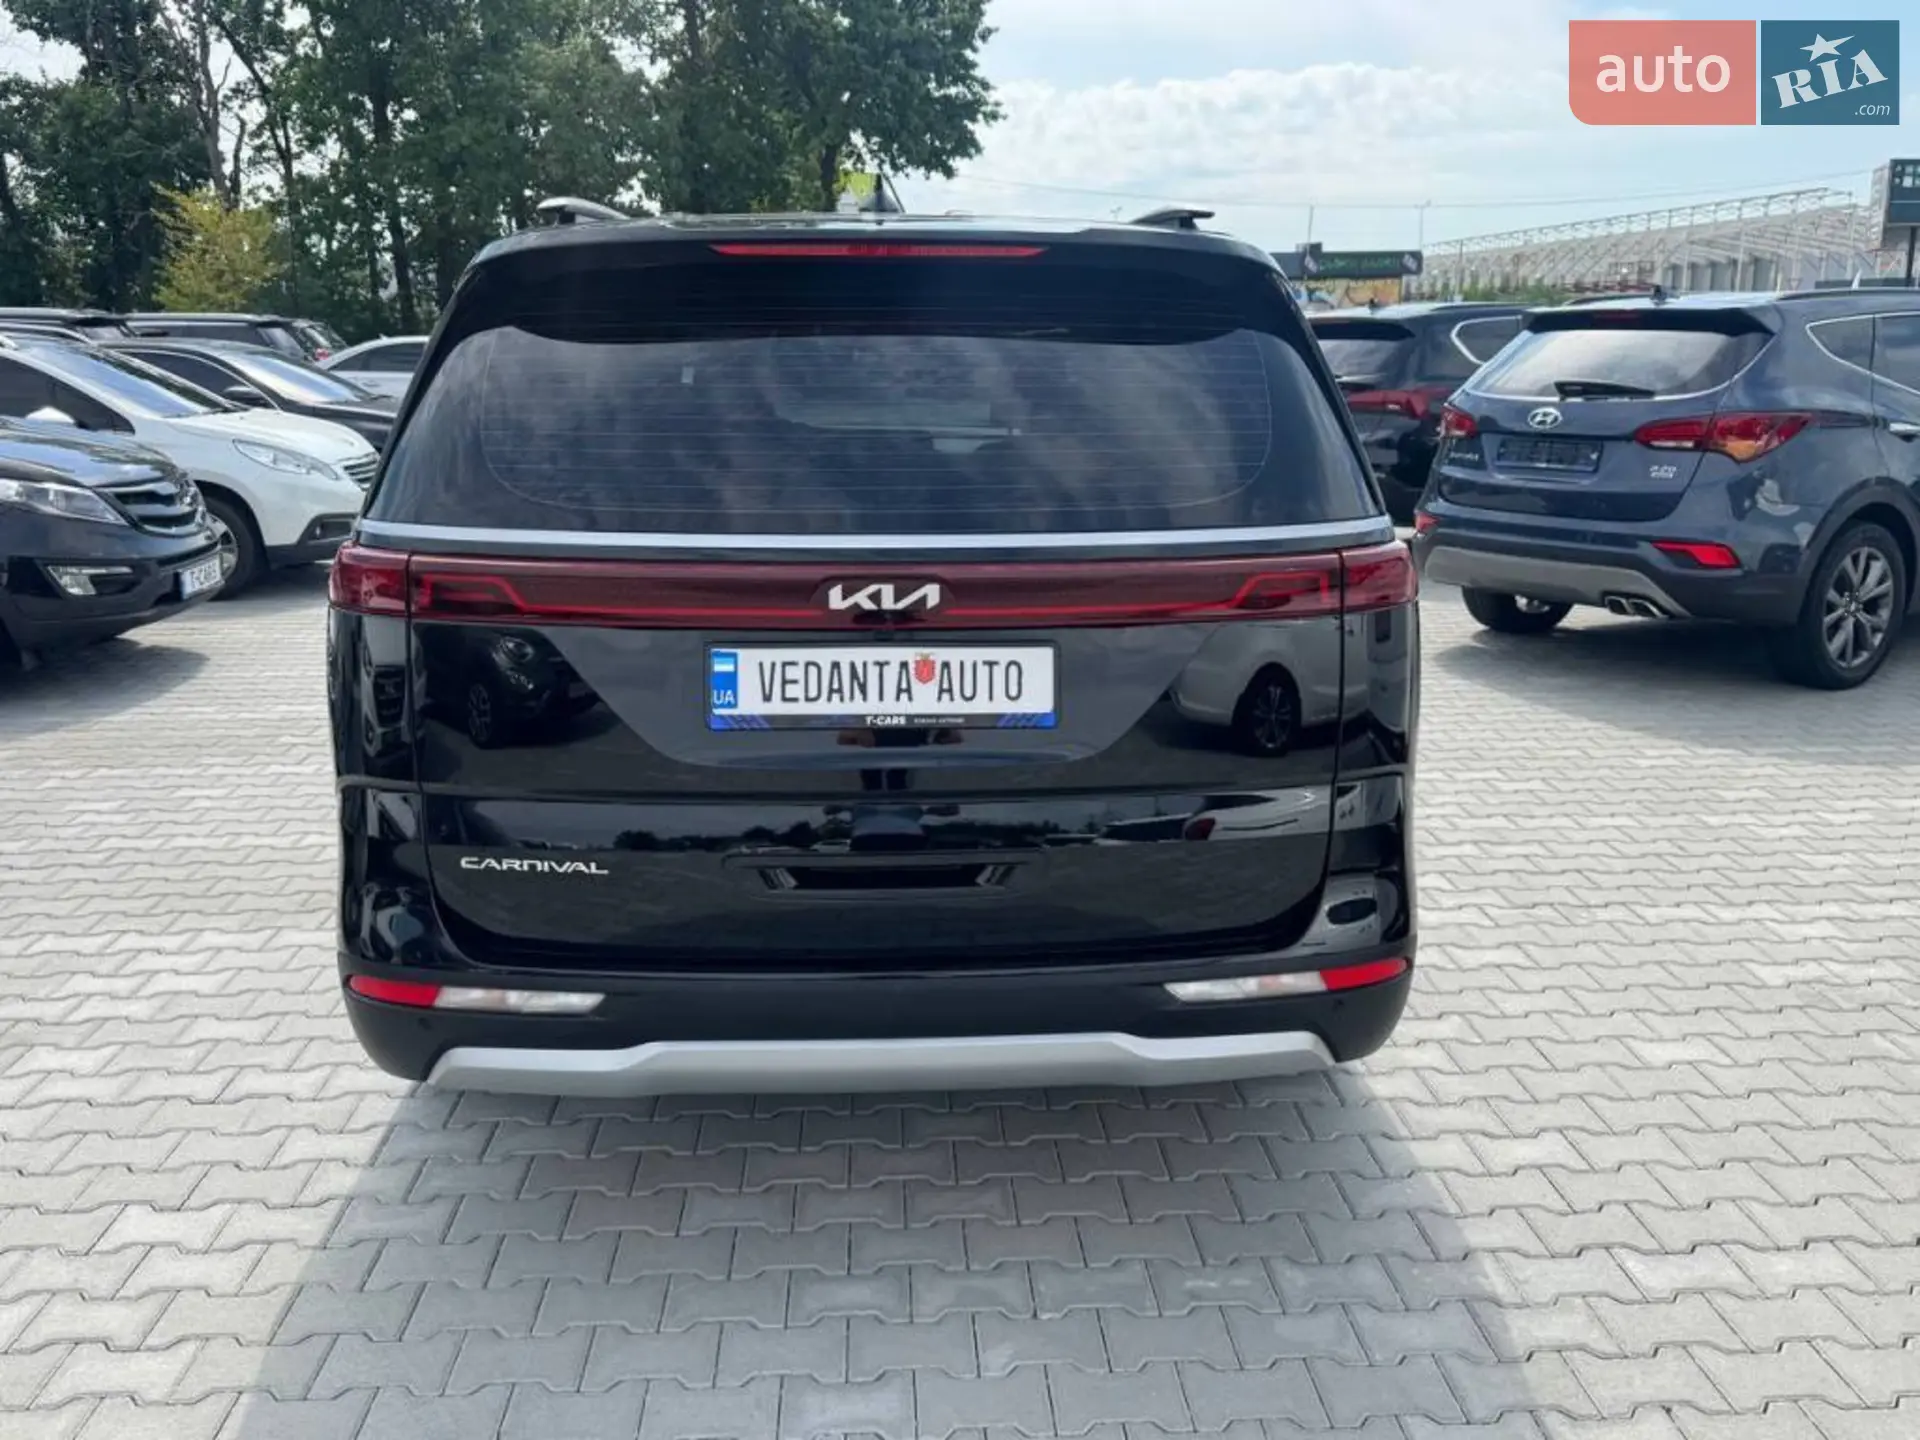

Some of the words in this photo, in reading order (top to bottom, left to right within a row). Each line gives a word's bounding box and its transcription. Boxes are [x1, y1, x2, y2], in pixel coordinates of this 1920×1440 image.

[828, 582, 941, 611] KIA
[758, 660, 914, 703] VEDANTA
[936, 659, 1025, 703] AUTO
[713, 689, 736, 705] UA
[460, 856, 610, 875] CARNIVAL
